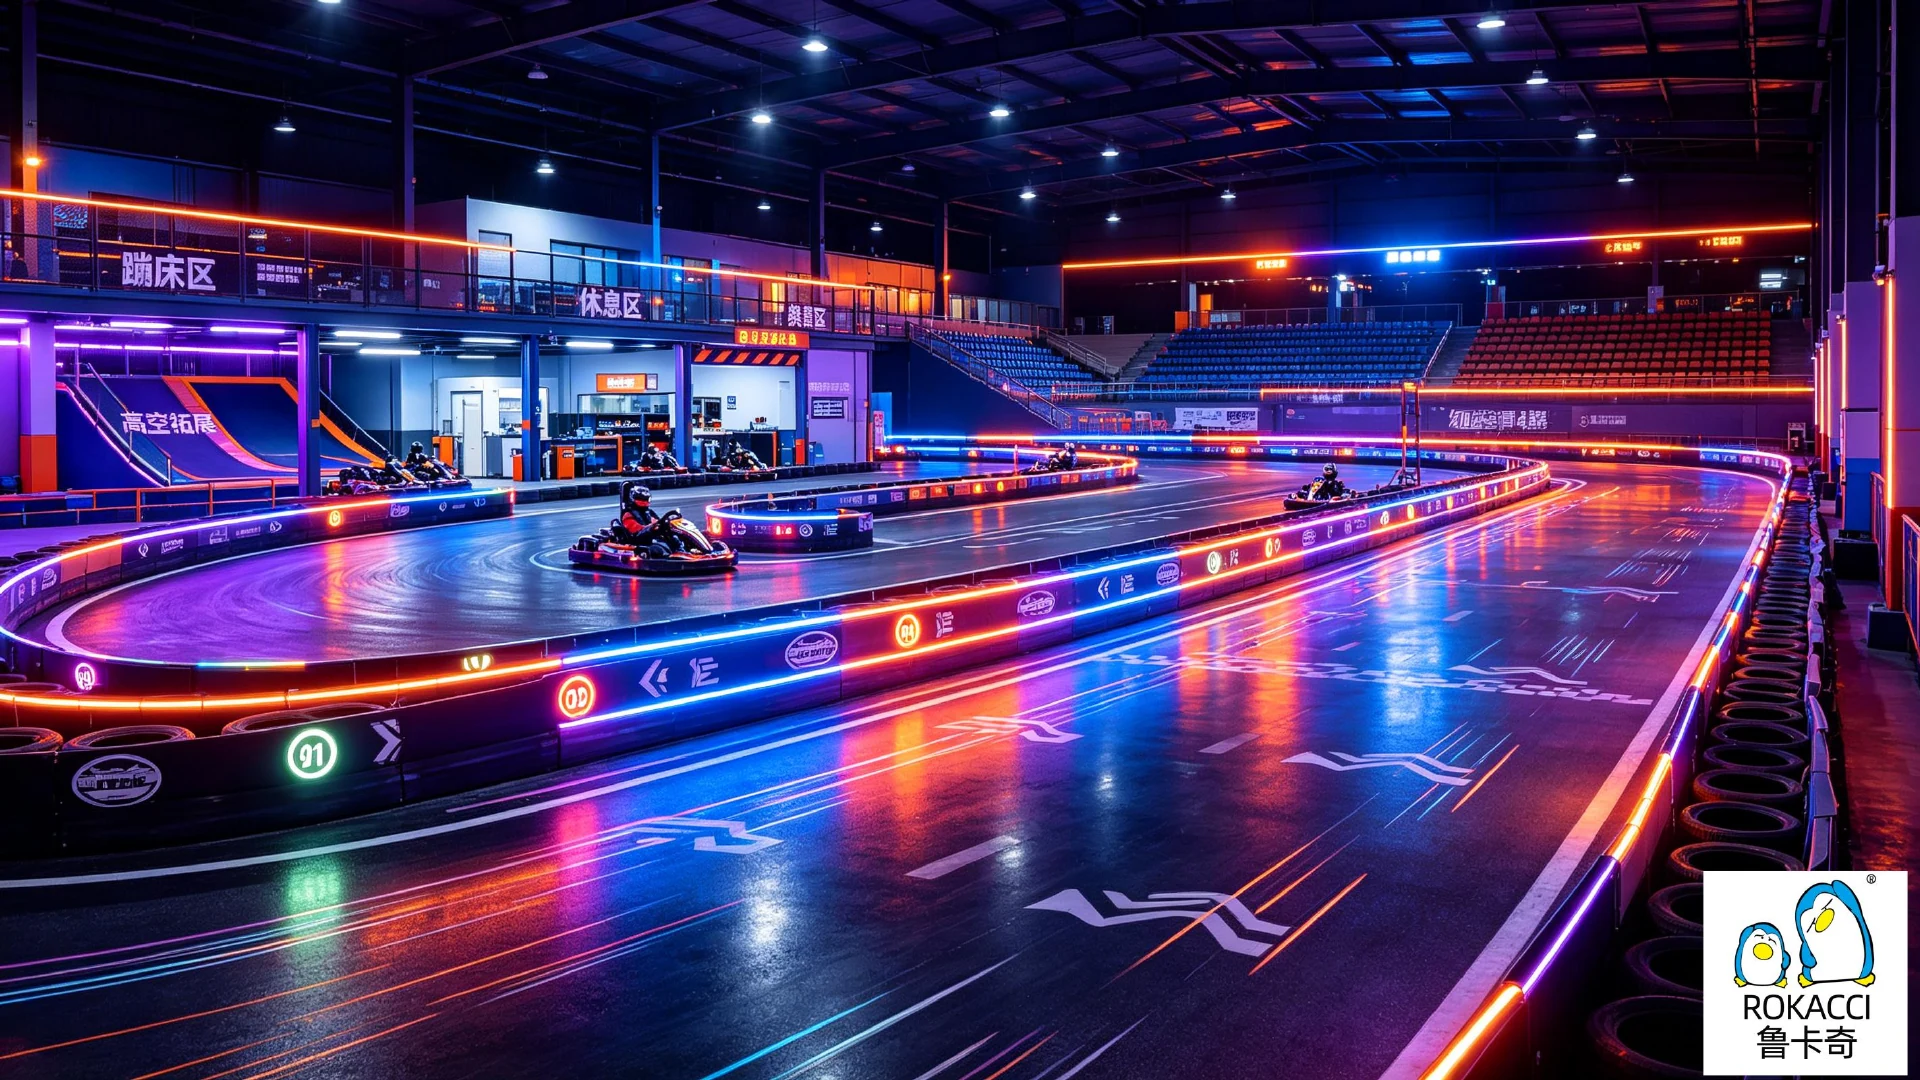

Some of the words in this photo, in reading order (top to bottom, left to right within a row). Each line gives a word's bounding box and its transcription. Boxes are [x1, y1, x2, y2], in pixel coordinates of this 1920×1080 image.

[122, 251, 217, 292] 蹦床区
[579, 287, 642, 319] 休息区
